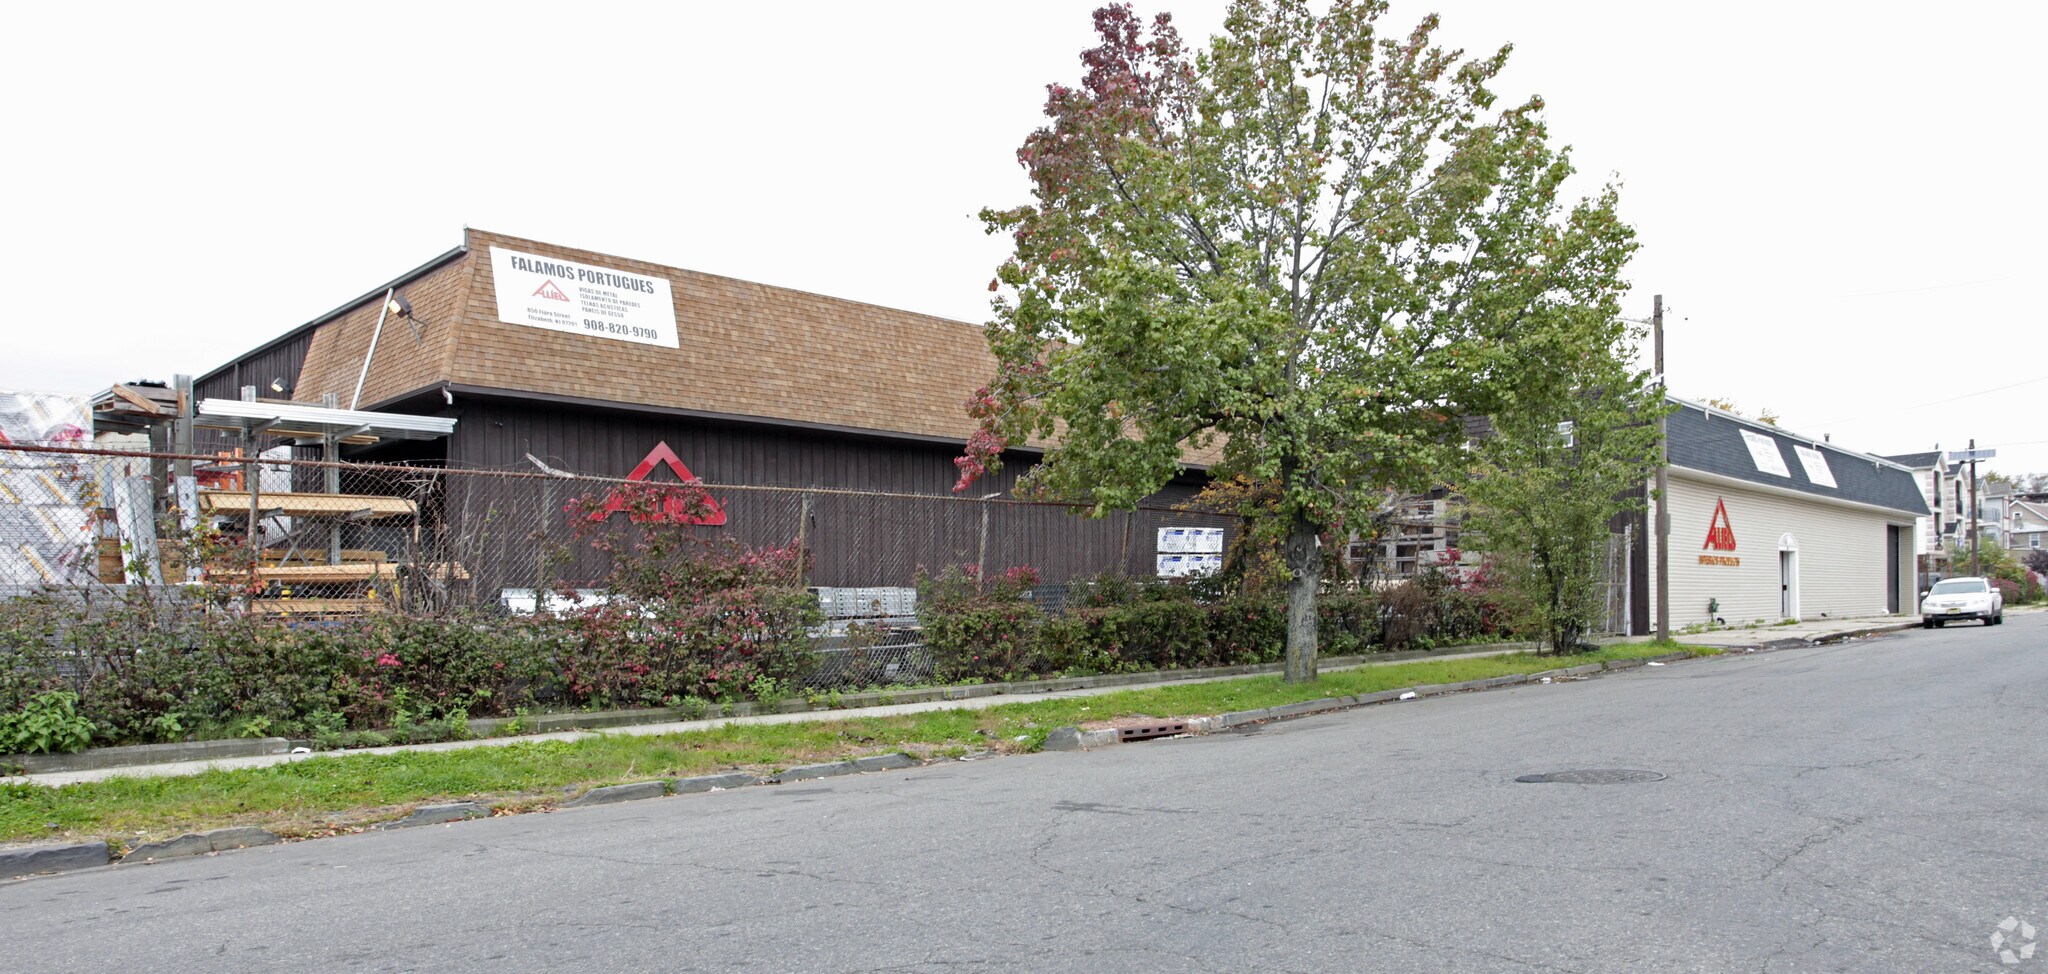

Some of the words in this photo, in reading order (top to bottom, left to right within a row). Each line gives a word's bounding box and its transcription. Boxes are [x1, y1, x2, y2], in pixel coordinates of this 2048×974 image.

[511, 256, 575, 280] FALAMOS
[578, 268, 655, 294] PORTUGUES
[619, 299, 641, 308] PAREDES
[553, 311, 571, 319] Street
[607, 310, 624, 318] GESSO
[583, 318, 658, 340] 908-820-9790
